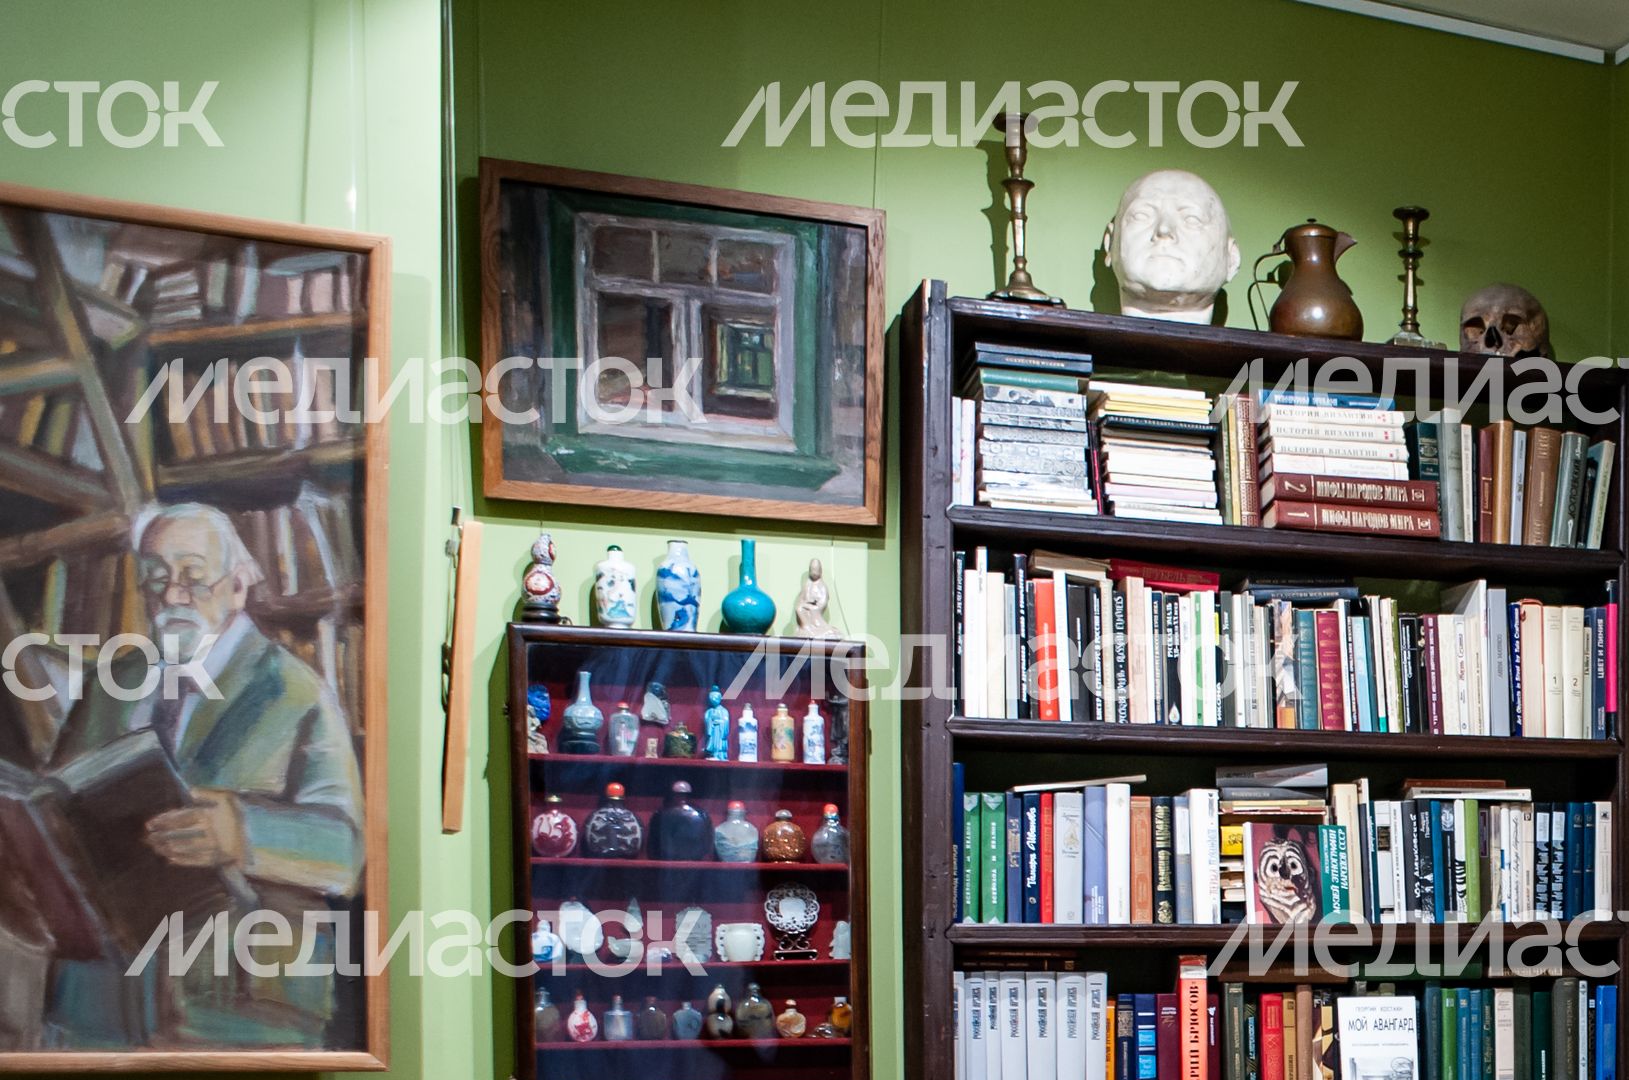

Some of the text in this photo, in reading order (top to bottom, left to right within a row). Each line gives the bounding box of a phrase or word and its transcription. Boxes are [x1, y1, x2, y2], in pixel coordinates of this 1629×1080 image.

[1276, 427, 1374, 437] ИСТОРИЯ ВИЗАНТИИ
[1317, 482, 1408, 502] МИФЫ НАРОДОВ МИРА
[1322, 509, 1414, 530] МИФЫ НАРОДОВ МИРА
[1026, 853, 1037, 888] Тамара
[1338, 828, 1349, 890] НАРОДОВ СССР
[1332, 886, 1341, 914] МУЗЕЙ
[1189, 985, 1199, 1043] БРЮСОВ
[1348, 1017, 1414, 1032] МОЙ АВАНГАРД
